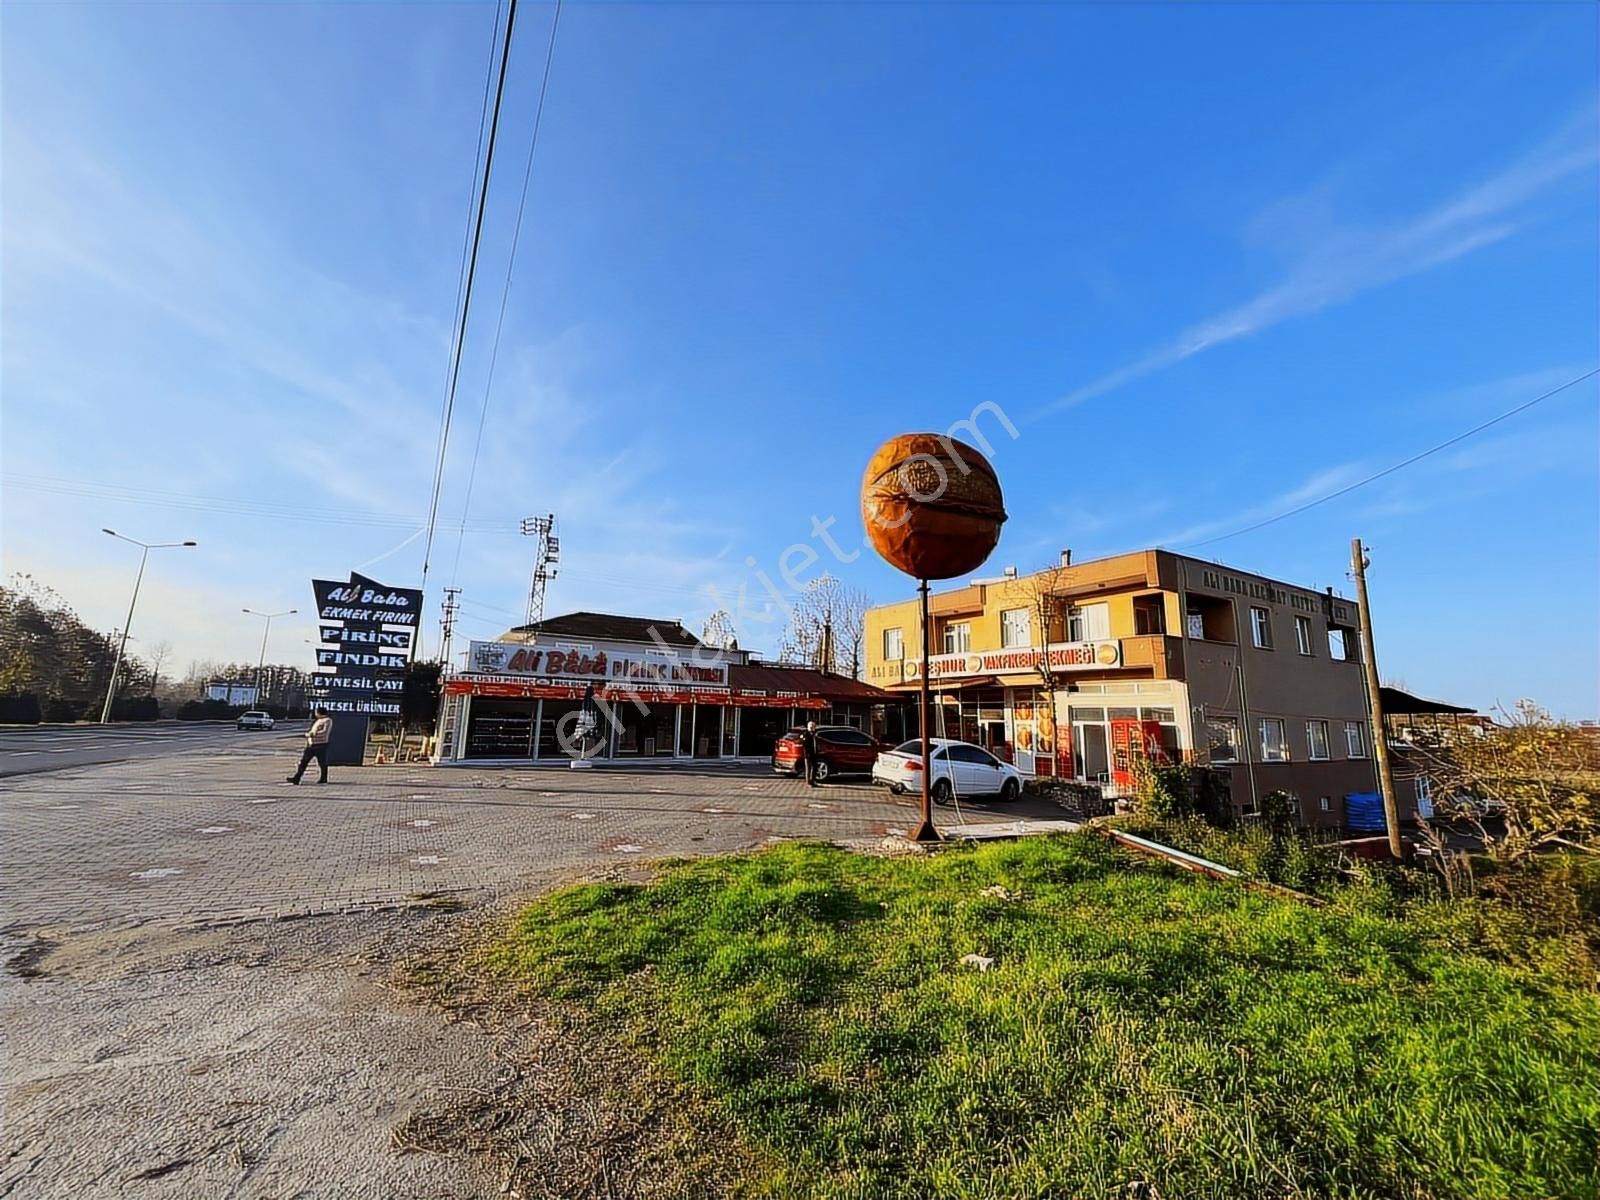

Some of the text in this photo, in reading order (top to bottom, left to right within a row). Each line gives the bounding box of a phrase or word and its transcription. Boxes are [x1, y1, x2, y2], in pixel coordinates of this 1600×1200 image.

[361, 589, 409, 606] Baba
[321, 606, 415, 624] EKMEK FIRINI
[322, 627, 409, 647] PİRİNÇ
[318, 651, 405, 668] FINDIK
[507, 648, 544, 673] Ali
[1048, 643, 1096, 666] EKMEĞİ
[313, 676, 404, 691] EYNESİL ÇAYI
[309, 699, 401, 714] YÖRESEL ÜRÜNLER
